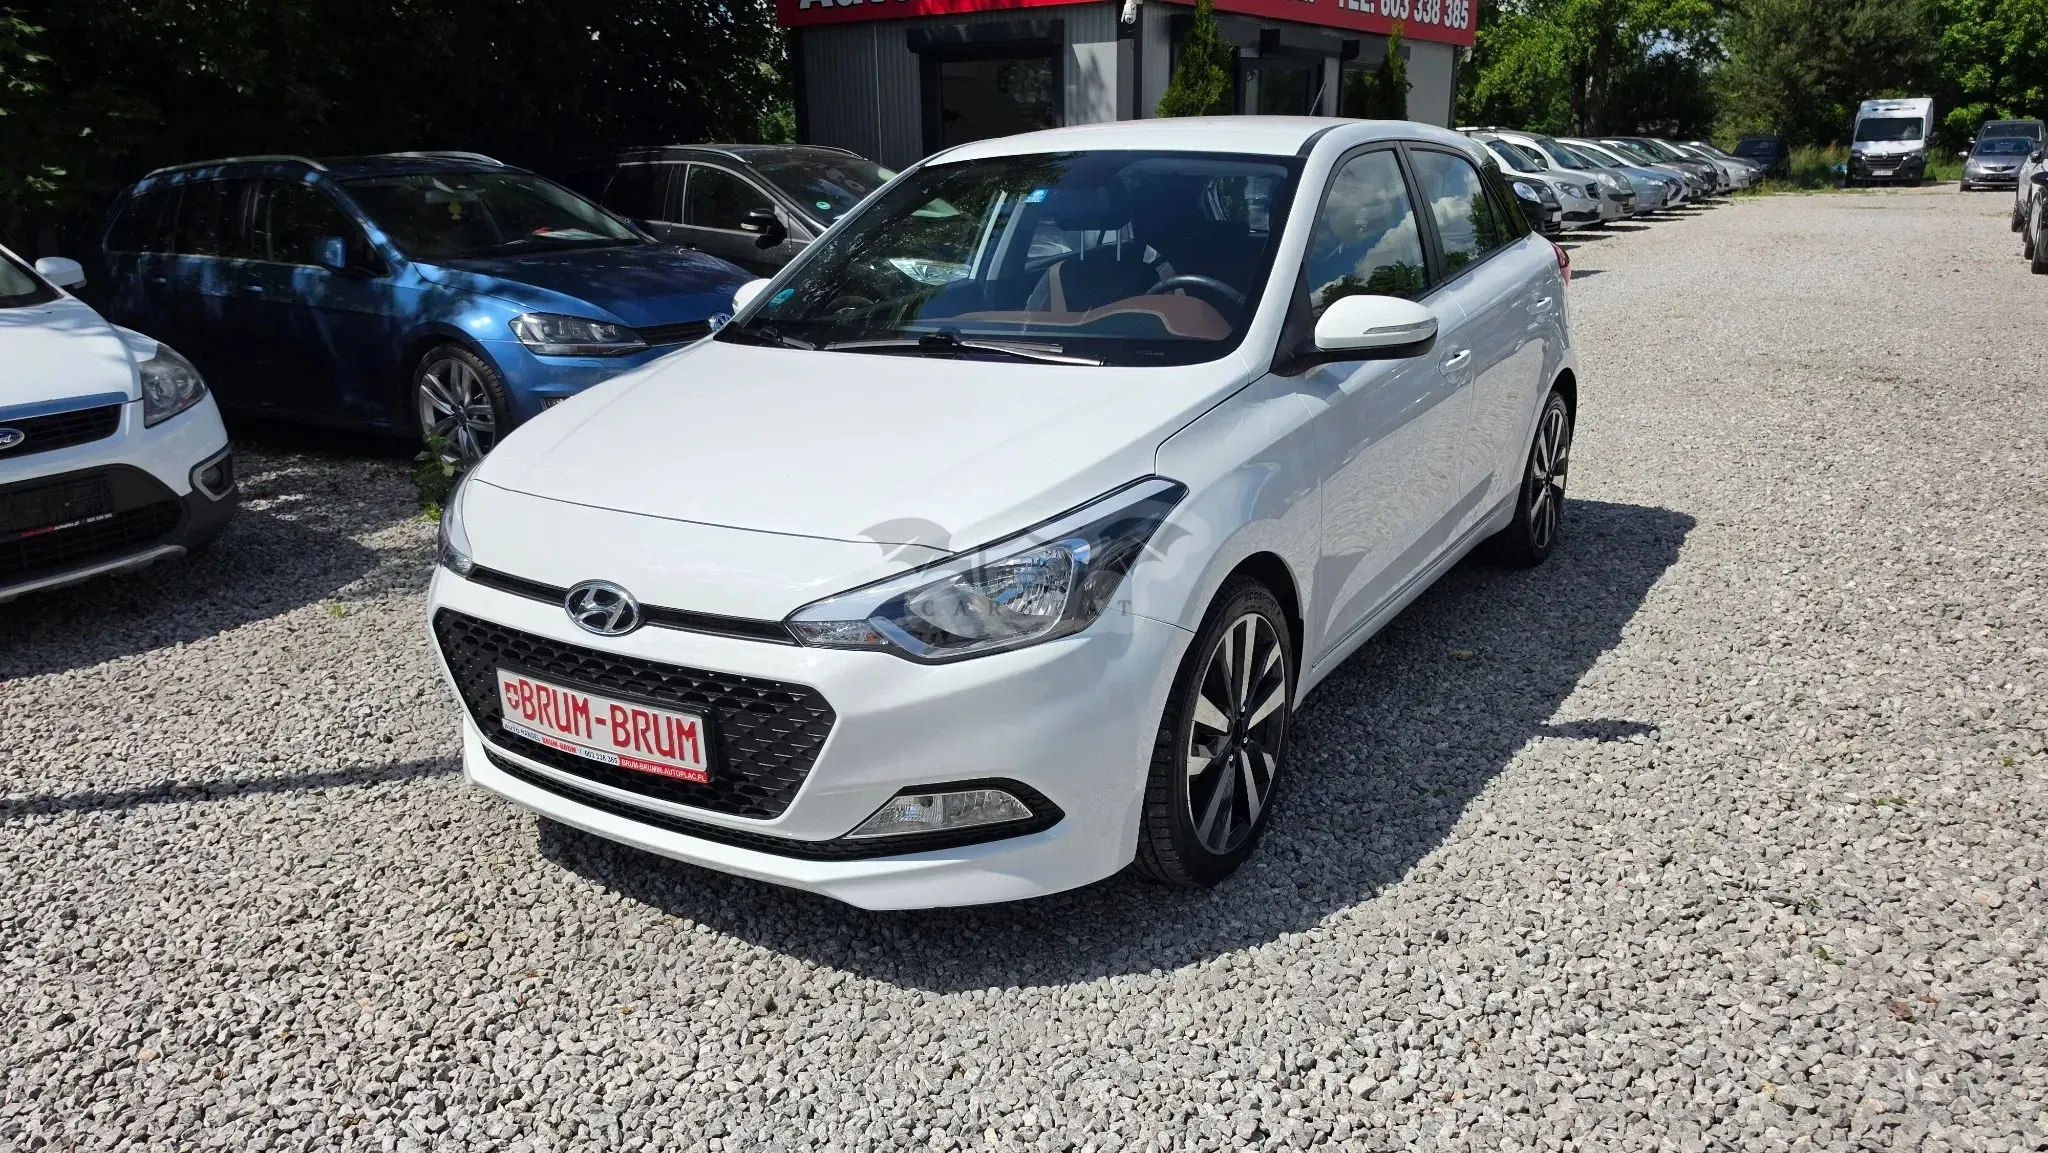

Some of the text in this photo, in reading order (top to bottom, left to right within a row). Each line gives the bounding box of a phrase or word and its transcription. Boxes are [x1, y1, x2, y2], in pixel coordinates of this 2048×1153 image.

[1381, 0, 1410, 20] 603
[1414, 0, 1441, 25] 338
[1444, 0, 1469, 30] 385
[518, 678, 700, 764] BRUM-BRUM
